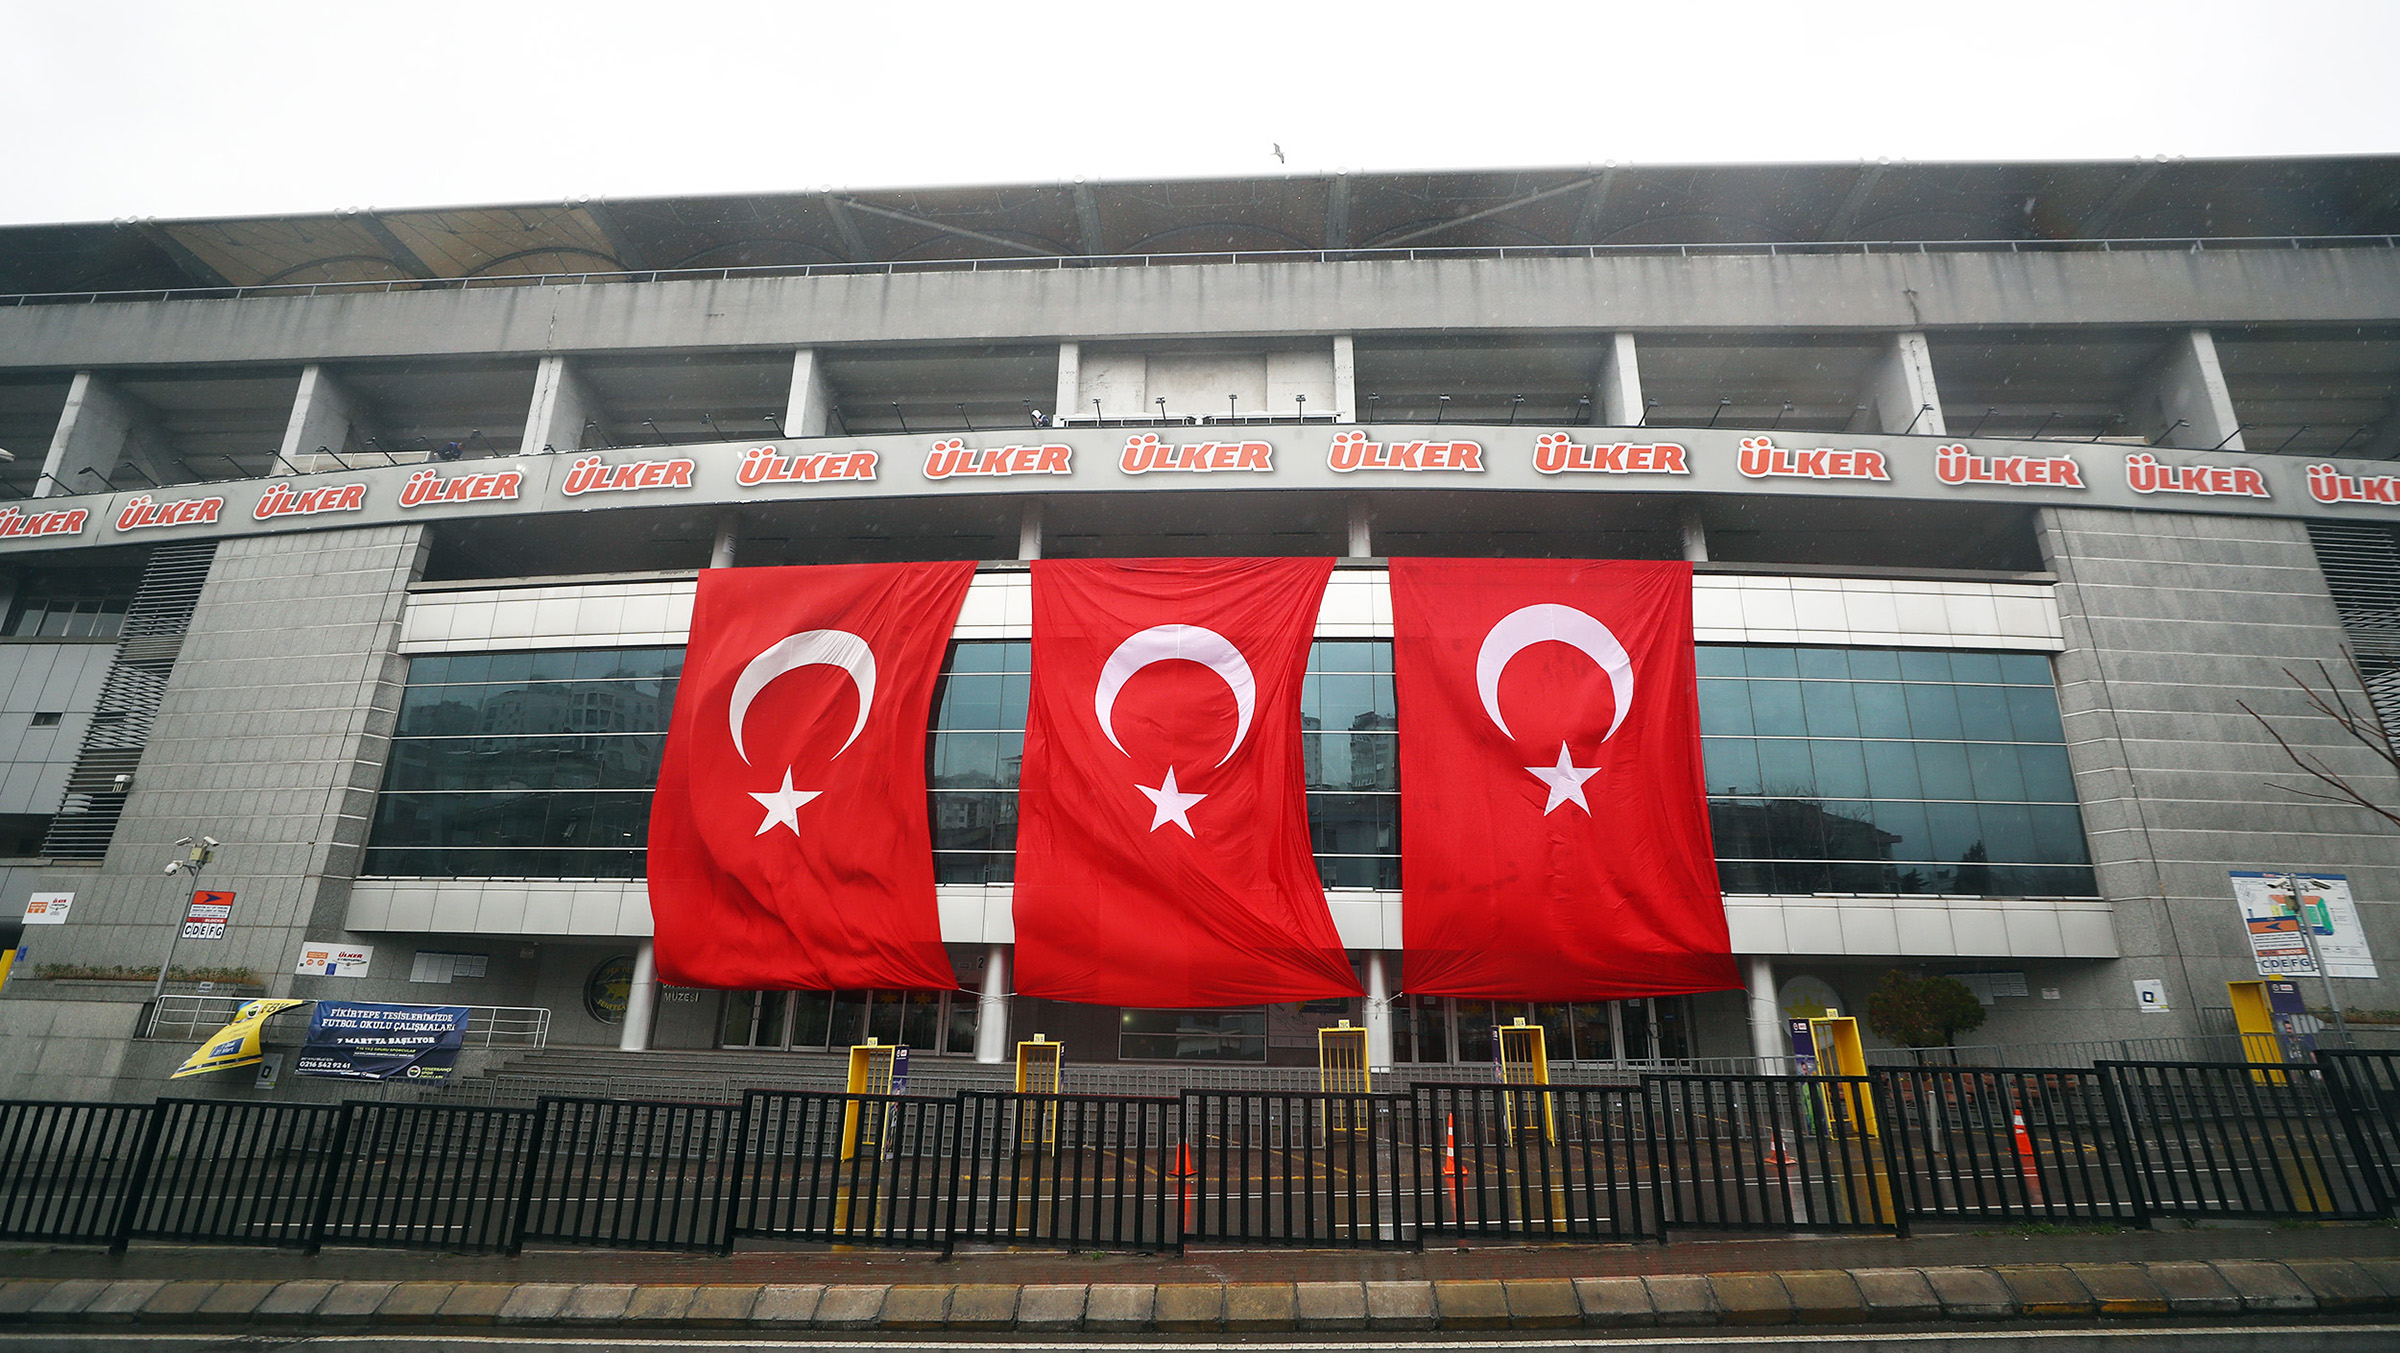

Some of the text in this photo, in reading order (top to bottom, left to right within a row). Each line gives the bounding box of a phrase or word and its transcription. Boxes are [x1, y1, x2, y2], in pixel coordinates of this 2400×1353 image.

[737, 446, 878, 486] ÜLKER
[924, 438, 1071, 479] ÜLKER
[1120, 433, 1271, 474] ÜLKER
[1328, 431, 1482, 472] ÜLKER
[1533, 432, 1687, 473] ÜLKER
[1738, 436, 1887, 480] ÜLKER
[1936, 444, 2082, 488] ÜLKER
[399, 469, 522, 507] ÜLKER
[563, 456, 694, 496] ÜLKER
[2126, 453, 2267, 497] ÜLKER
[115, 496, 224, 531] ÜLKER
[253, 482, 366, 520] ÜLKER
[0, 506, 88, 539] ÜLKER
[321, 1018, 358, 1028] FUTBOL
[360, 1020, 393, 1030] OKULU
[388, 1036, 436, 1046] BAŞLIYOR
